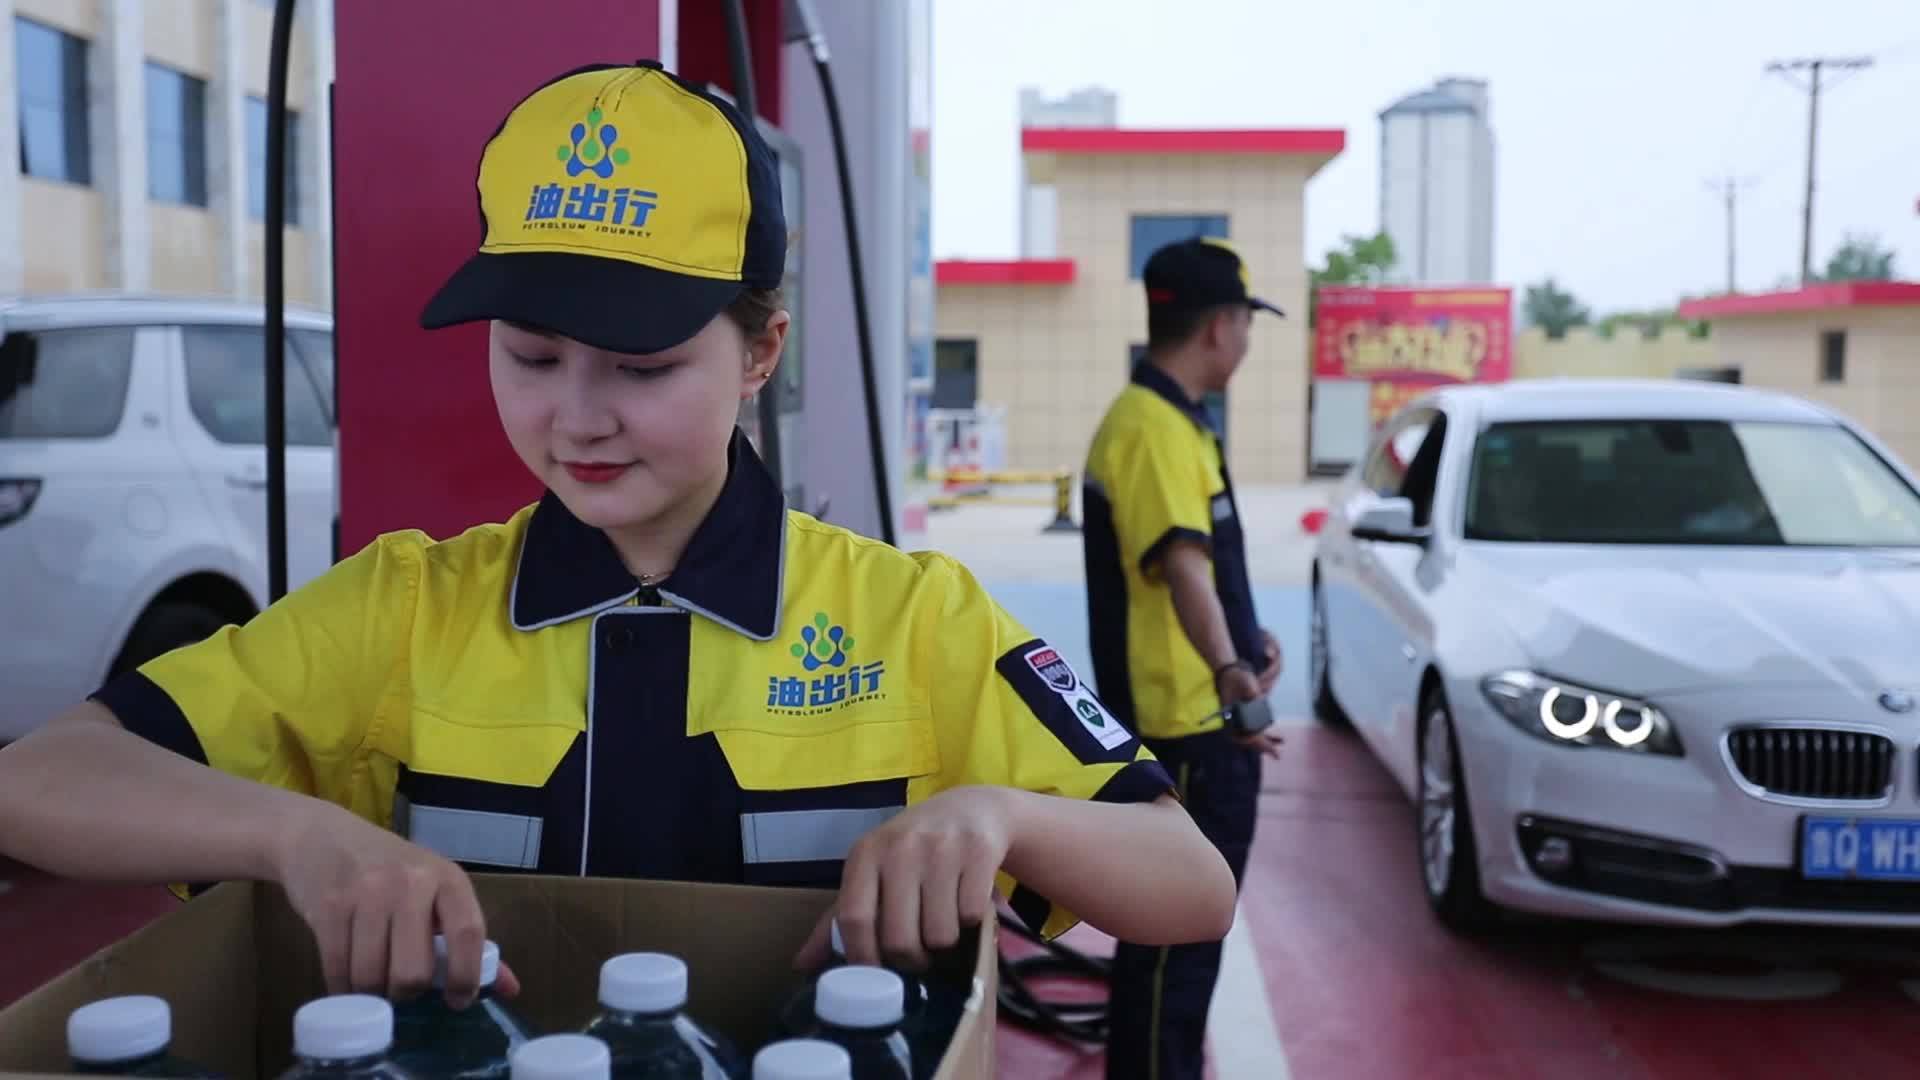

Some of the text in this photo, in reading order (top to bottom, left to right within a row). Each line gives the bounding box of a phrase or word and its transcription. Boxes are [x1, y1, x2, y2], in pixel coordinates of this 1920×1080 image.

[526, 182, 658, 228] 油出行
[522, 221, 653, 238] PETROLEUM JOURNEY
[767, 660, 885, 707] 油出行
[766, 693, 887, 716] PETROLEUM JOURNEY
